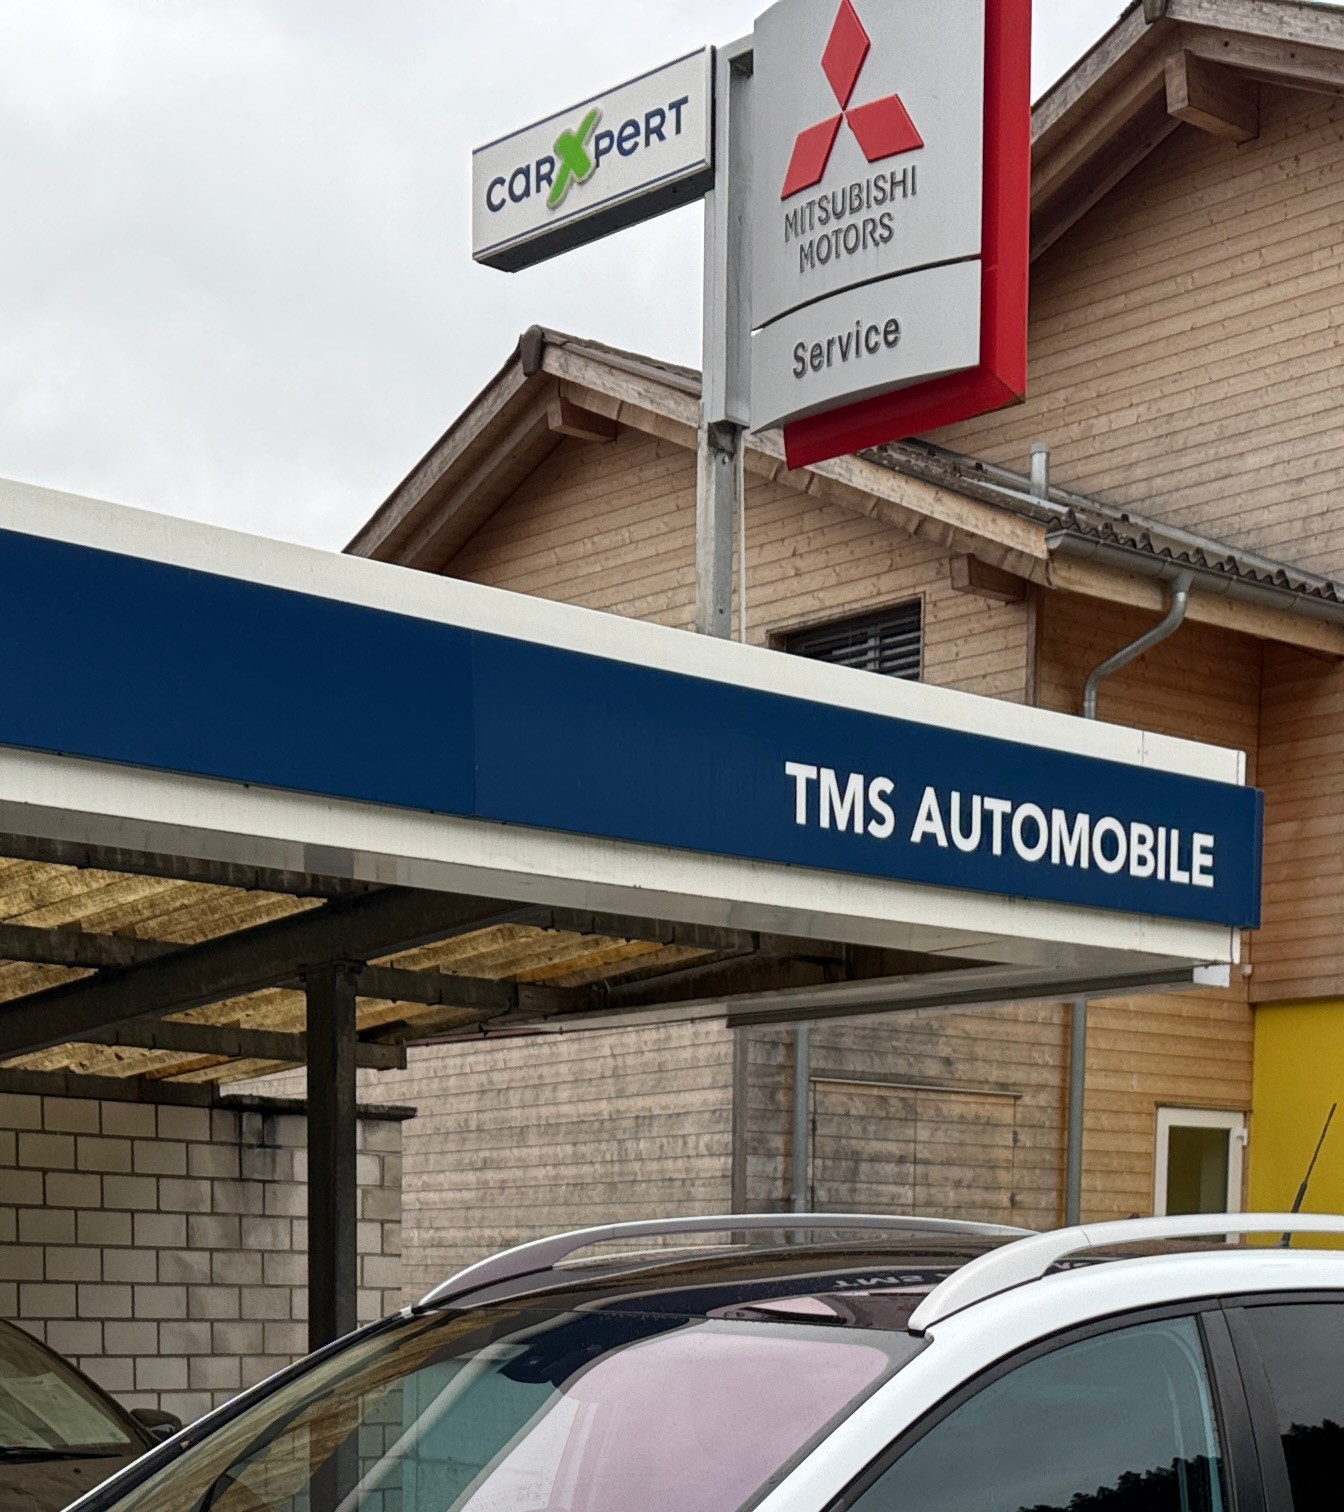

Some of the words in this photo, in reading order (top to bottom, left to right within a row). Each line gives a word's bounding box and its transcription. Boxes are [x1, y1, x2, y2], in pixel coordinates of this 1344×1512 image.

[783, 165, 918, 243] MITSUBISHI
[798, 212, 895, 273] MOTORS
[792, 317, 902, 379] Service
[784, 760, 896, 839] TMS
[910, 786, 1216, 888] AUTOMOBILE
